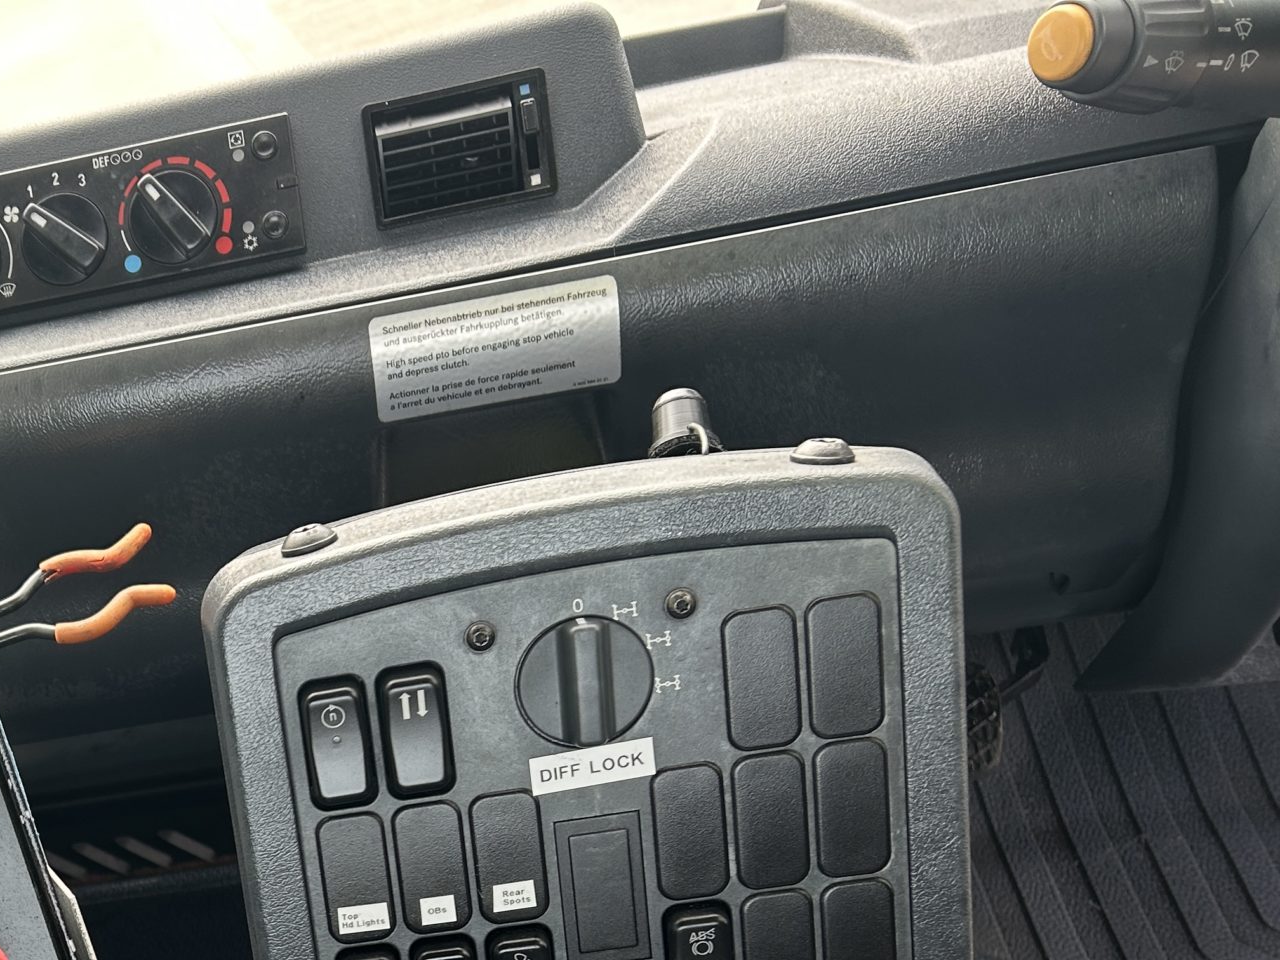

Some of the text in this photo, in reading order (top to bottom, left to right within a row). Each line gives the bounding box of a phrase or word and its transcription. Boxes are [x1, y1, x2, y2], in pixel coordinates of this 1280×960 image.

[51, 172, 61, 187] 2
[77, 173, 87, 187] 3
[26, 184, 35, 199] 1
[382, 288, 608, 335] Schneller Nebenabtrieb nur bei stehendem Fahrzeug
[384, 337, 400, 347] und
[460, 316, 519, 334] Fahrkupplung
[386, 328, 575, 369] High speed pto before engaging stop vehicle
[387, 359, 470, 381] and depress clutch.
[389, 360, 576, 400] Actionner la prise de force rapide seulement
[424, 396, 435, 405] du
[474, 388, 483, 396] et
[485, 386, 496, 394] en
[572, 598, 584, 613] 0
[539, 752, 646, 784] DIFF LOCK
[502, 888, 525, 897] Rear
[503, 895, 532, 906] Spots
[342, 913, 359, 922] Top
[427, 906, 448, 916] OBs
[342, 917, 386, 929] Hd Lights
